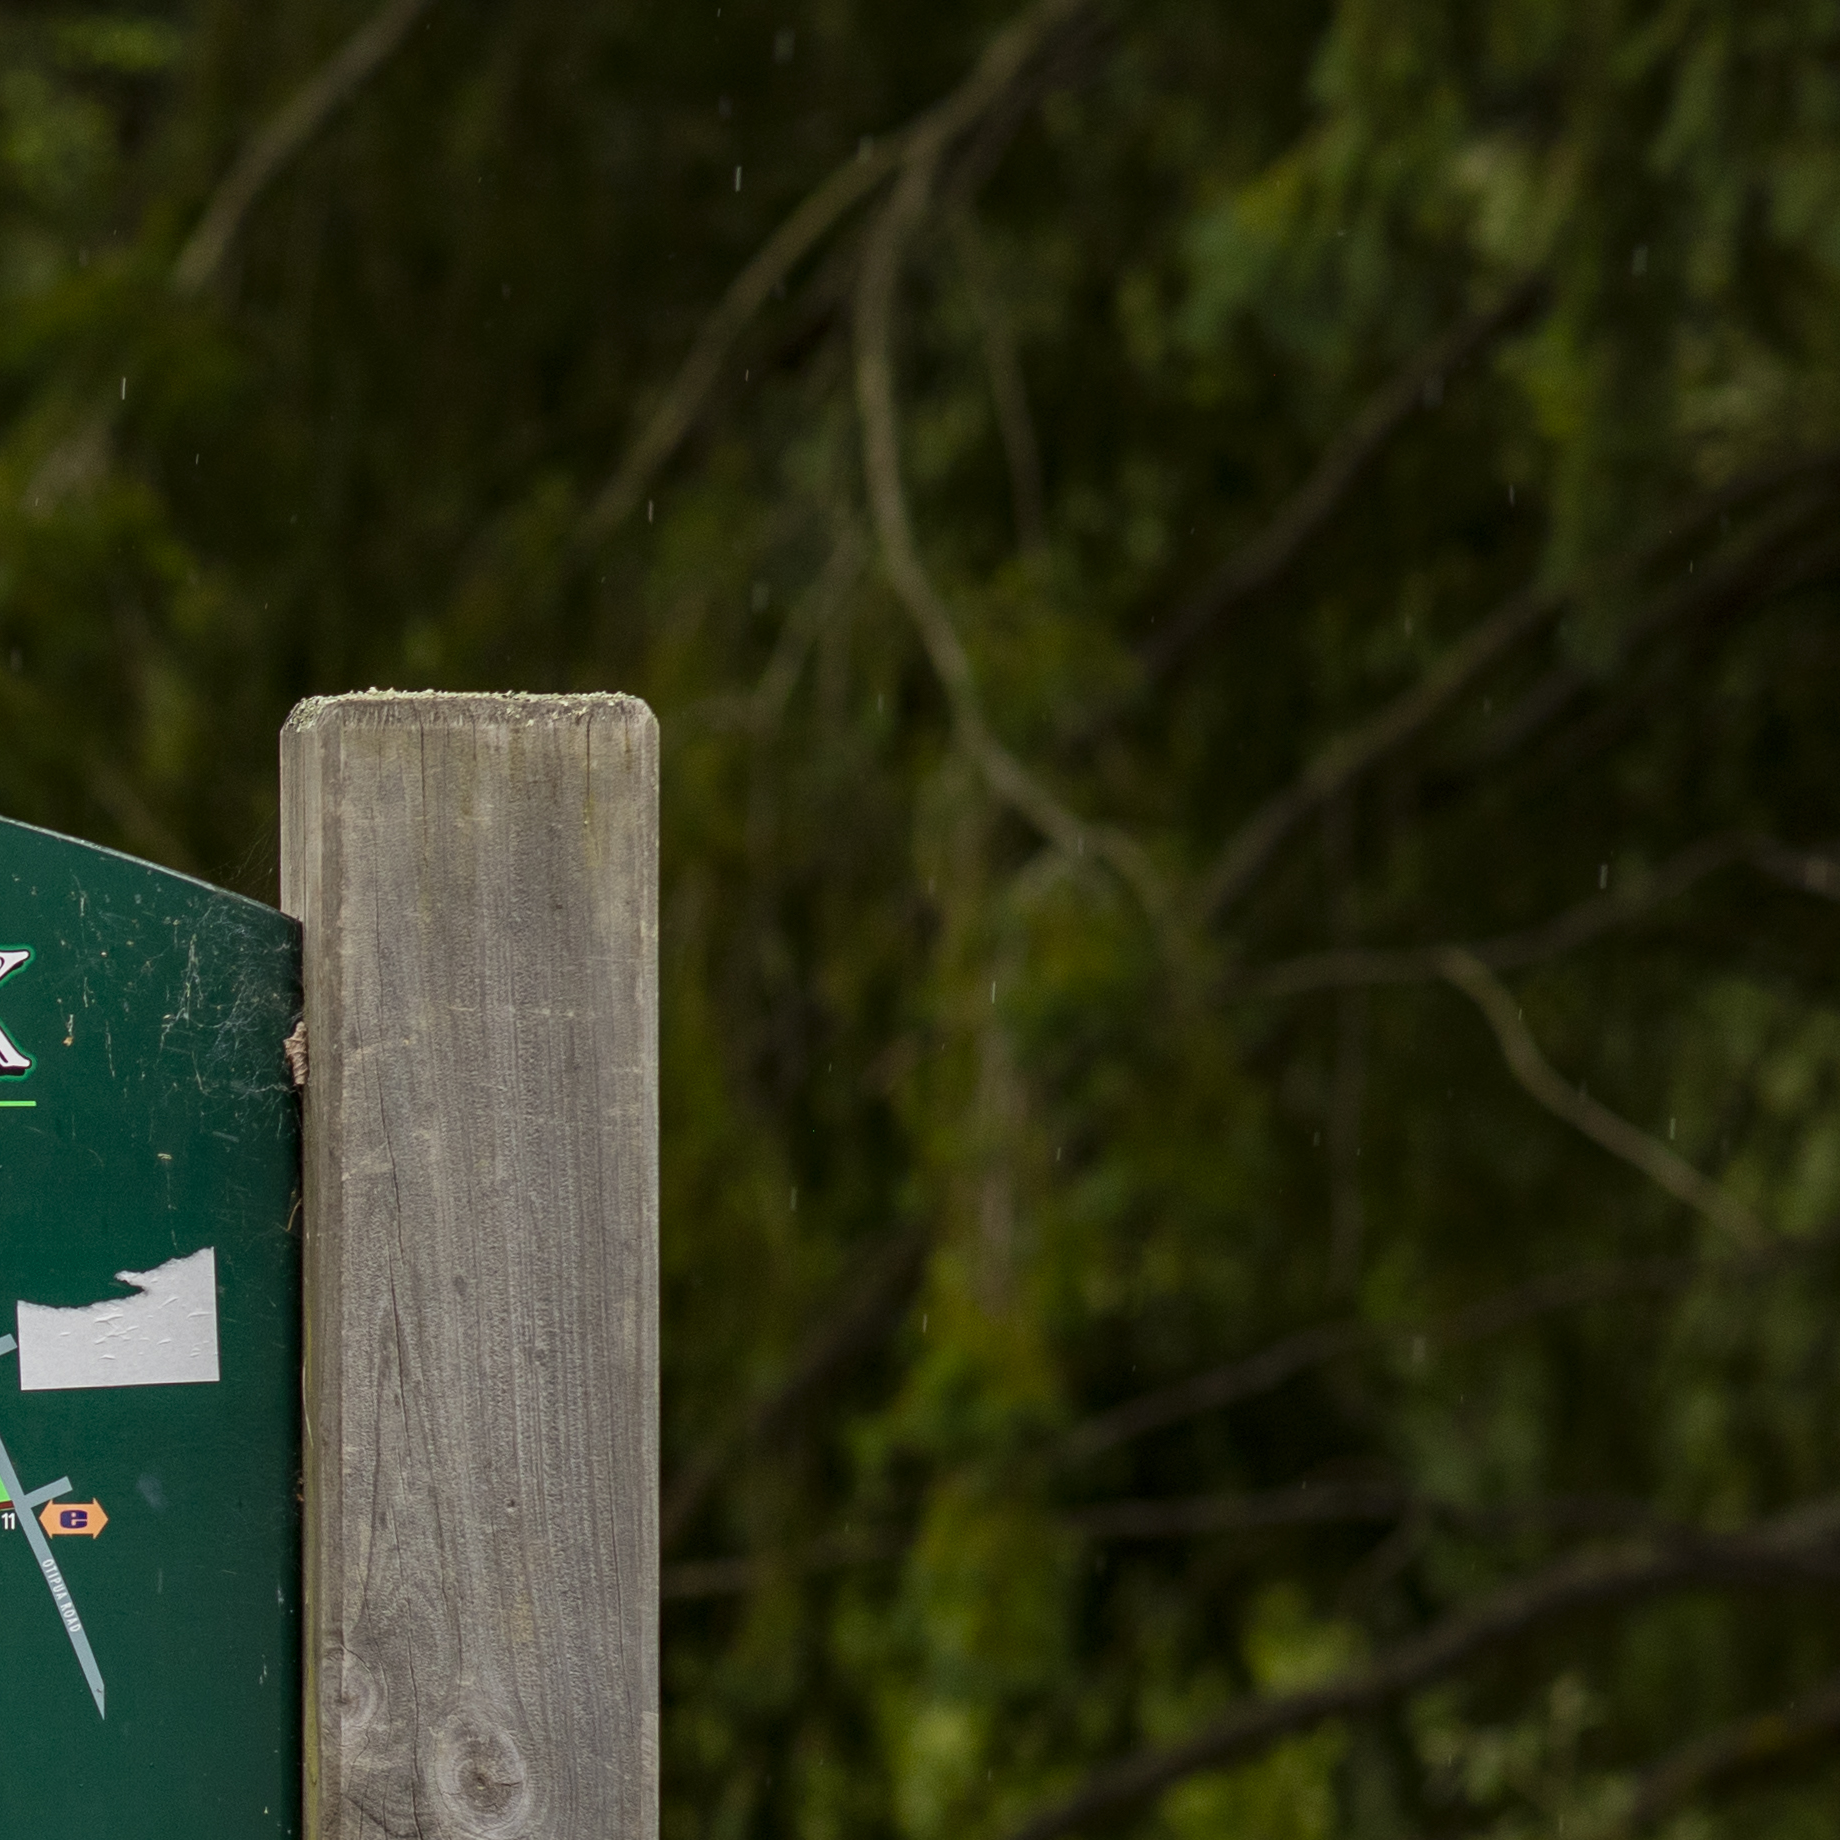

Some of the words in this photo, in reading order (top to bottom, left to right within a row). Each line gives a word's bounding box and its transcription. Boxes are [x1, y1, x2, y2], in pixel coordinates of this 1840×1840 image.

[1, 1512, 16, 1530] 11
[42, 1559, 68, 1600] OTIPUA
[61, 1602, 81, 1632] ROAD
